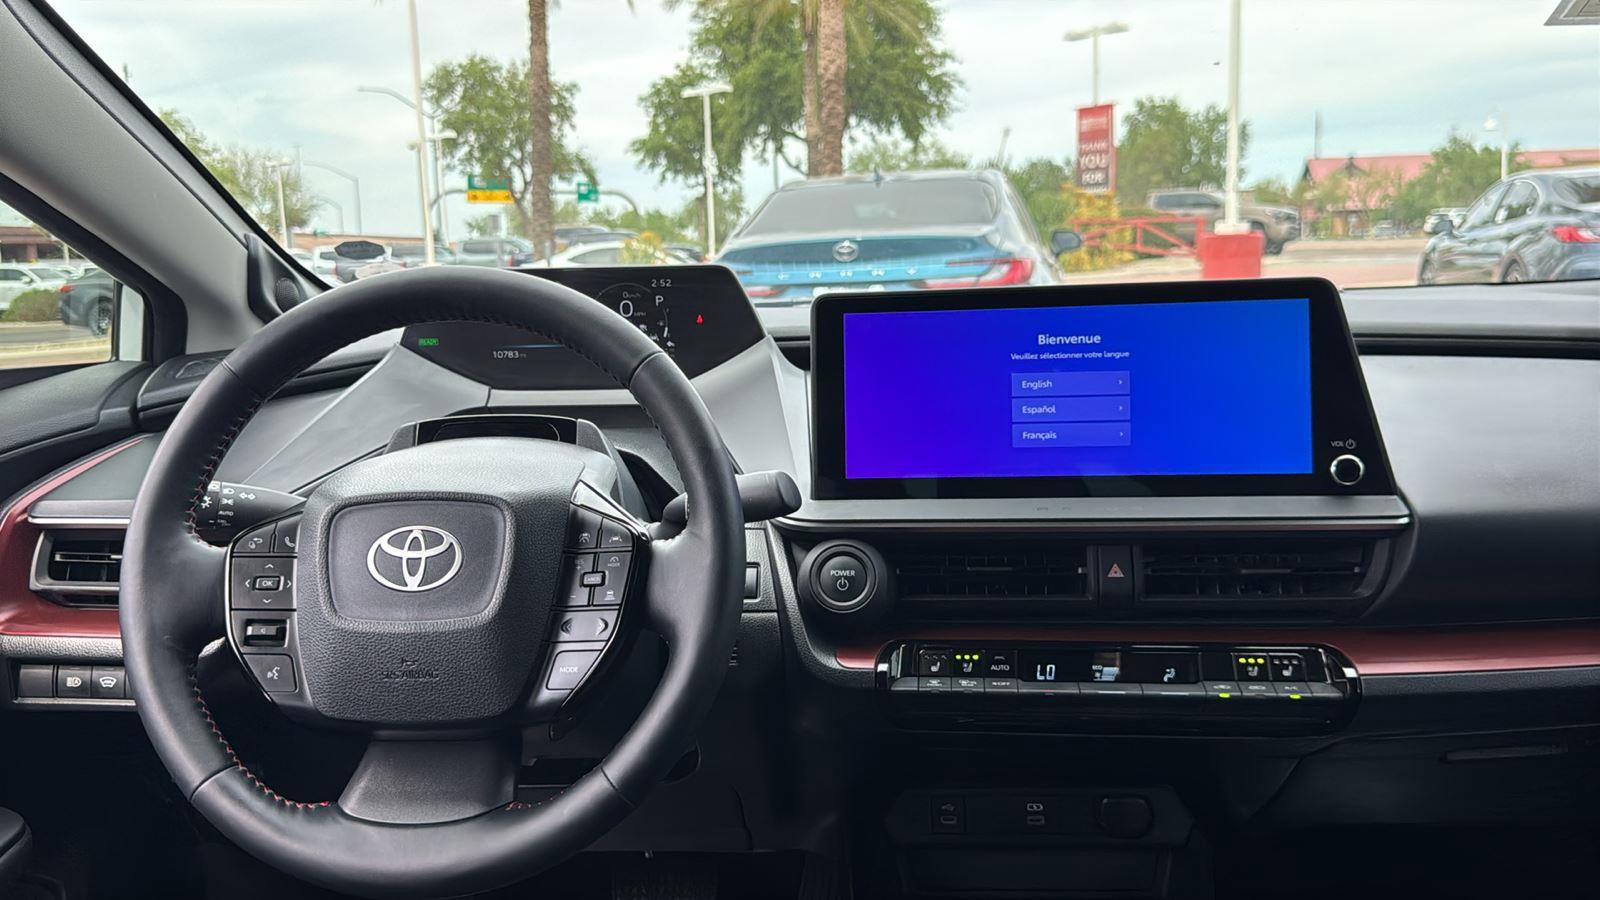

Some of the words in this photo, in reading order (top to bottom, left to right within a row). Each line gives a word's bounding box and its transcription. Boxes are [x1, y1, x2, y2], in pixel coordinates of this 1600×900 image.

[1080, 153, 1108, 170] YOU
[655, 295, 664, 306] P
[619, 300, 633, 317] 0
[1037, 334, 1102, 345] Bienvenue
[493, 351, 519, 359] 10783
[1010, 352, 1038, 360] Veuillez
[1040, 351, 1083, 359] sélectionner
[1103, 350, 1130, 359] langue
[1021, 380, 1053, 390] English
[1022, 405, 1056, 415] Español
[1022, 431, 1057, 441] Français
[830, 569, 855, 577] POWER
[262, 579, 273, 588] OK
[559, 666, 579, 674] MODE
